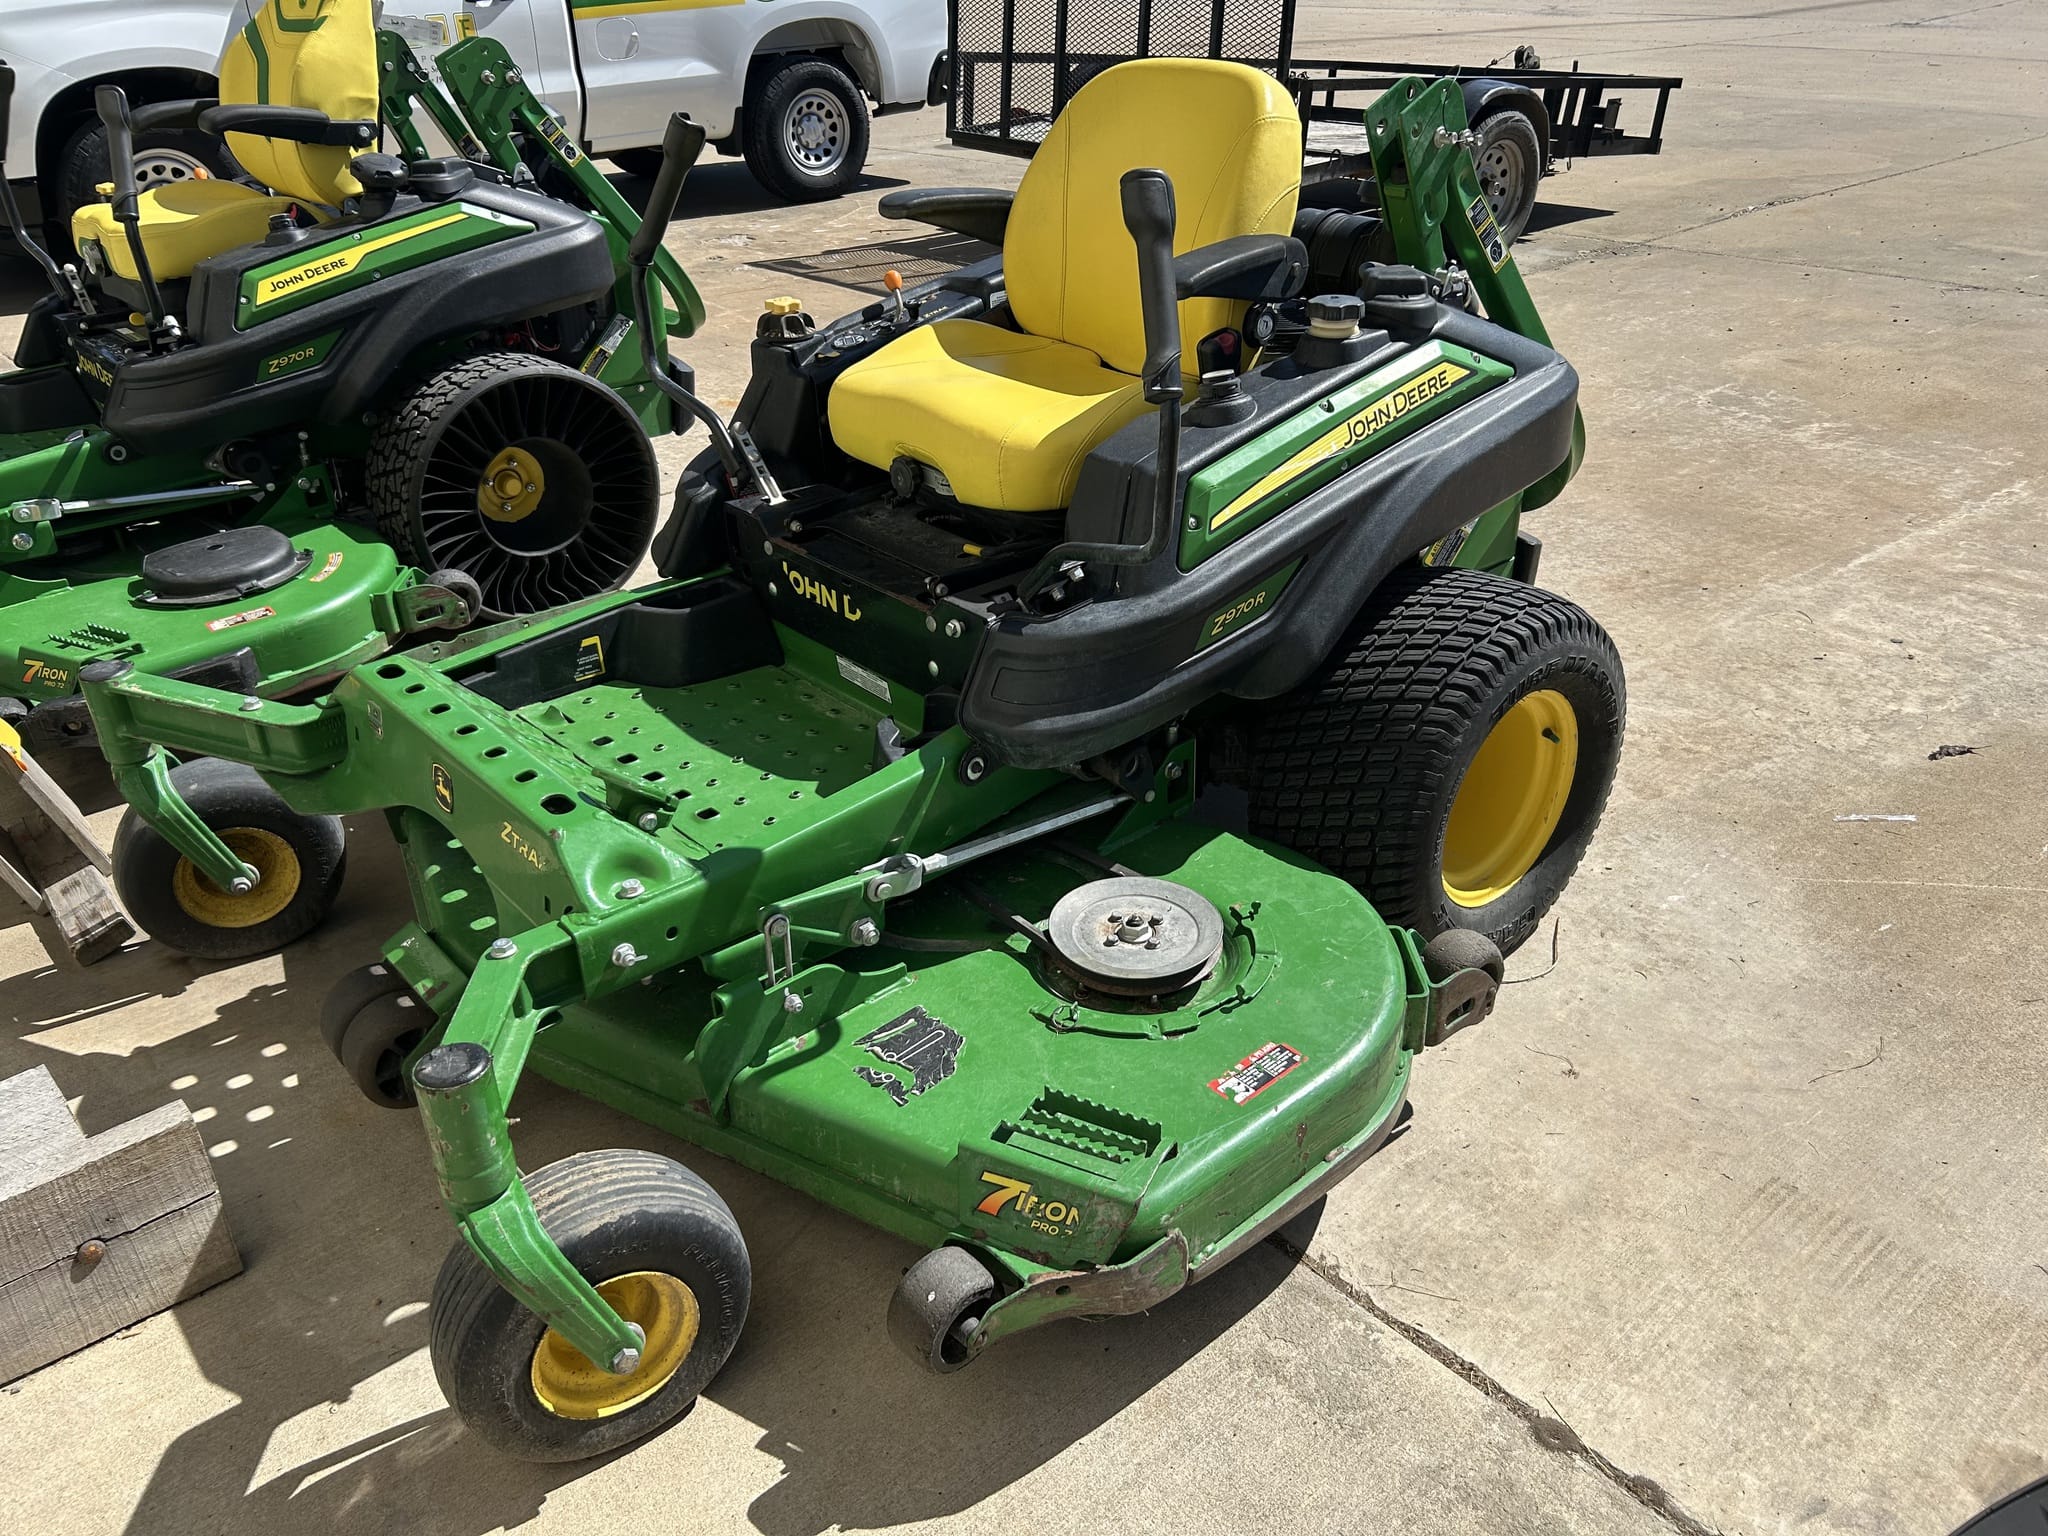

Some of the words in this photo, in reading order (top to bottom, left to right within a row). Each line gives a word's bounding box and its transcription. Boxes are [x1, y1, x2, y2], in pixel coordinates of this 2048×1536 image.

[270, 274, 304, 293] JOHN
[303, 258, 348, 279] DEERE
[268, 347, 314, 374] Z970R
[1344, 404, 1391, 445] JOHN
[1392, 370, 1449, 414] DEERE
[1211, 591, 1266, 636] Z970R
[1030, 1219, 1060, 1236] PRO
